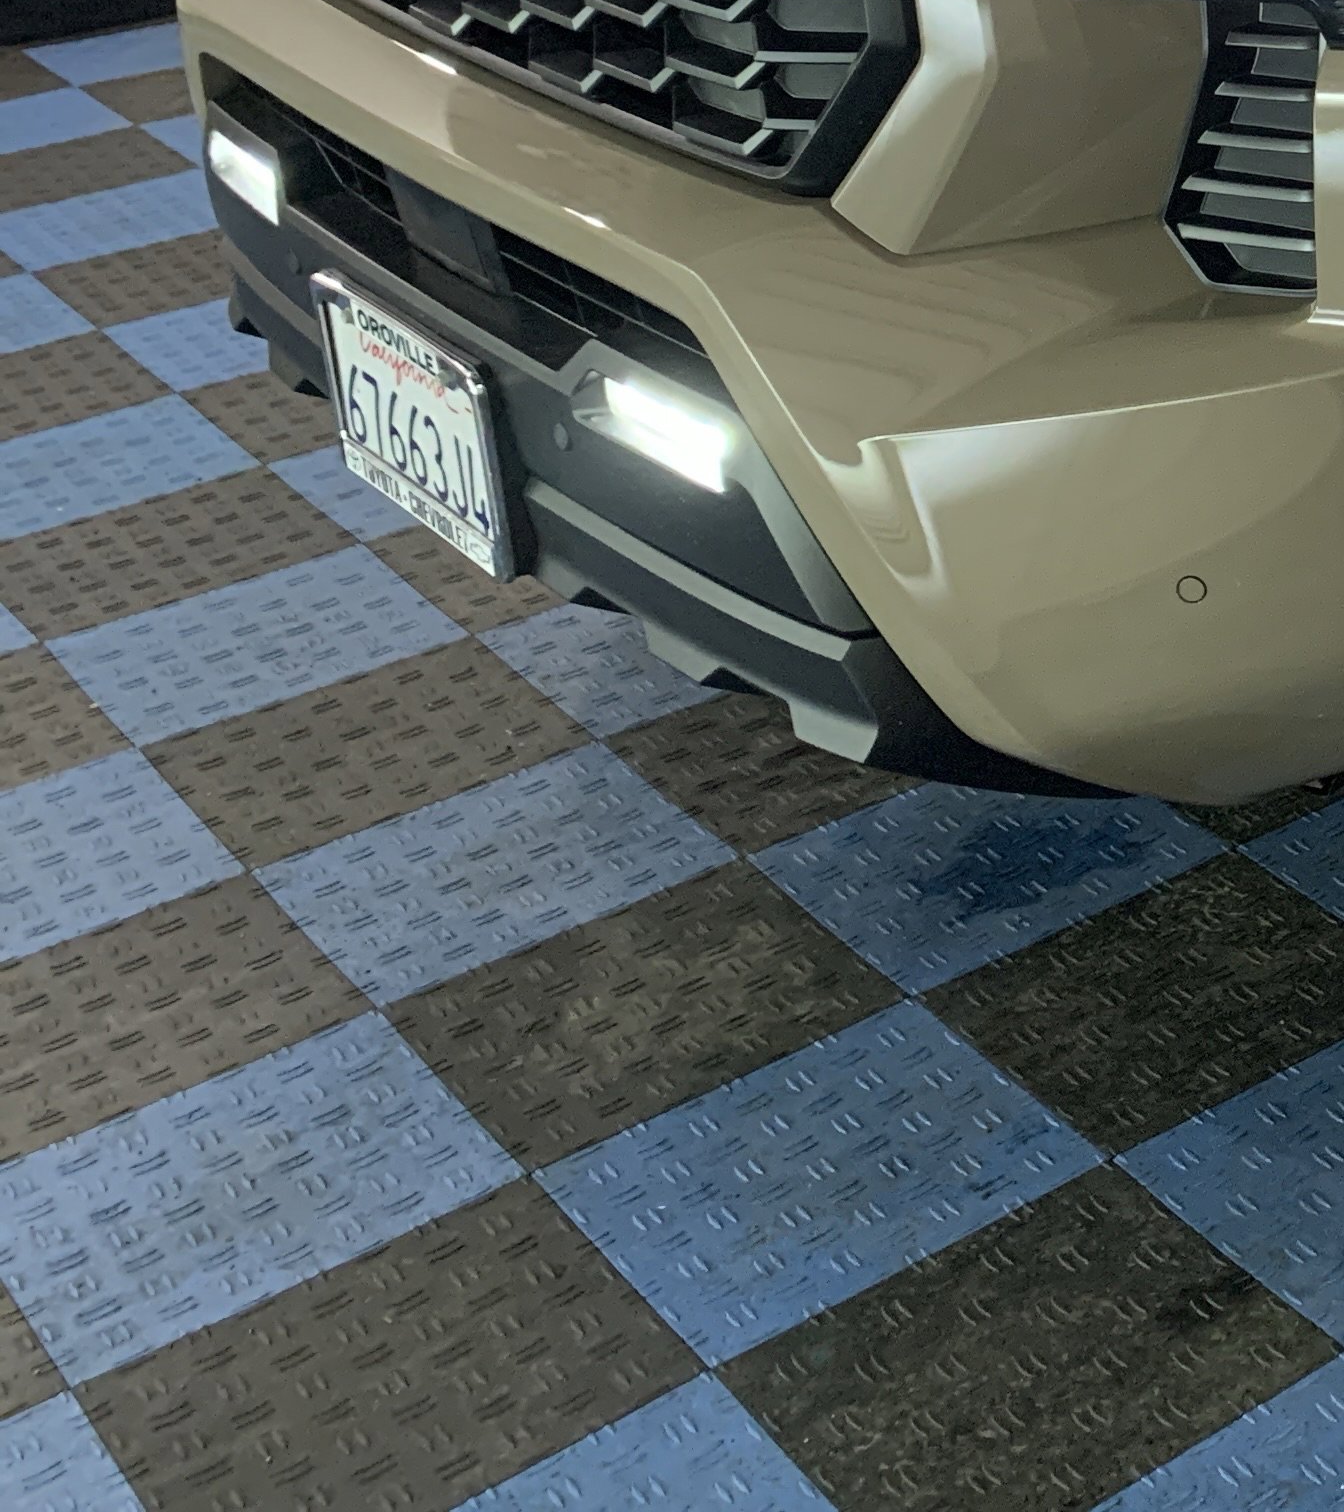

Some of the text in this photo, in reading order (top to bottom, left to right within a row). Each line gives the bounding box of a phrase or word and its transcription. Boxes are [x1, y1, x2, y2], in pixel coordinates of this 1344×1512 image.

[357, 309, 437, 377] OROVILLE
[349, 364, 491, 539] 67663J4
[361, 455, 402, 503] TOYOTA
